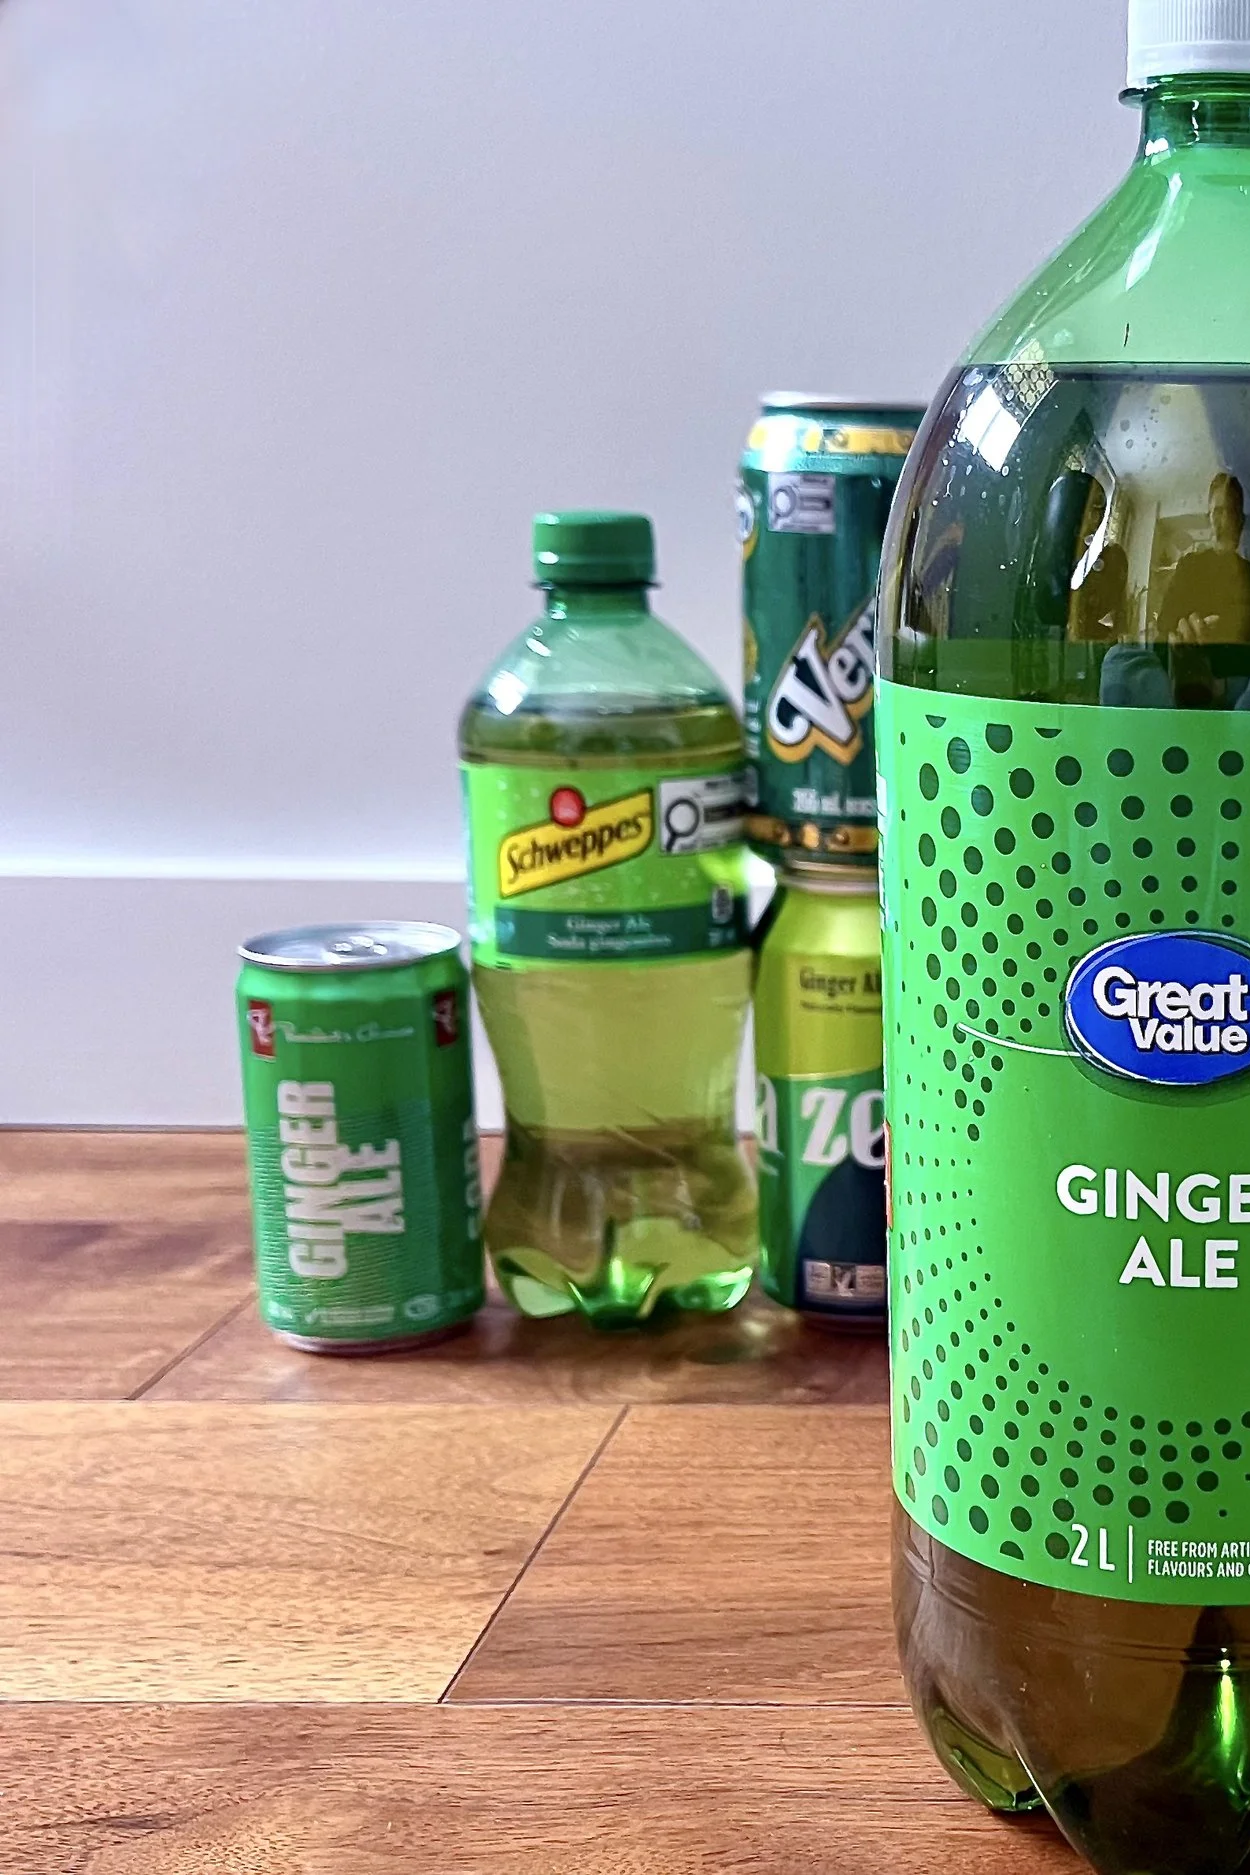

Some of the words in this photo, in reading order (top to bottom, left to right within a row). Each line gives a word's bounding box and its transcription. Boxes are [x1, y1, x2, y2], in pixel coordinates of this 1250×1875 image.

[507, 816, 643, 884] Schweppes
[1093, 966, 1248, 1021] Great
[1129, 1016, 1248, 1053] Value
[277, 1081, 348, 1280] GINGER
[344, 1138, 405, 1234] ALE
[1119, 1235, 1239, 1288] ALE
[1070, 1523, 1089, 1567] 2
[1098, 1528, 1116, 1571] L
[1148, 1539, 1178, 1557] FREE
[1182, 1541, 1218, 1558] FROM
[1148, 1560, 1213, 1577] FLAVOURS
[1217, 1561, 1245, 1577] AND
